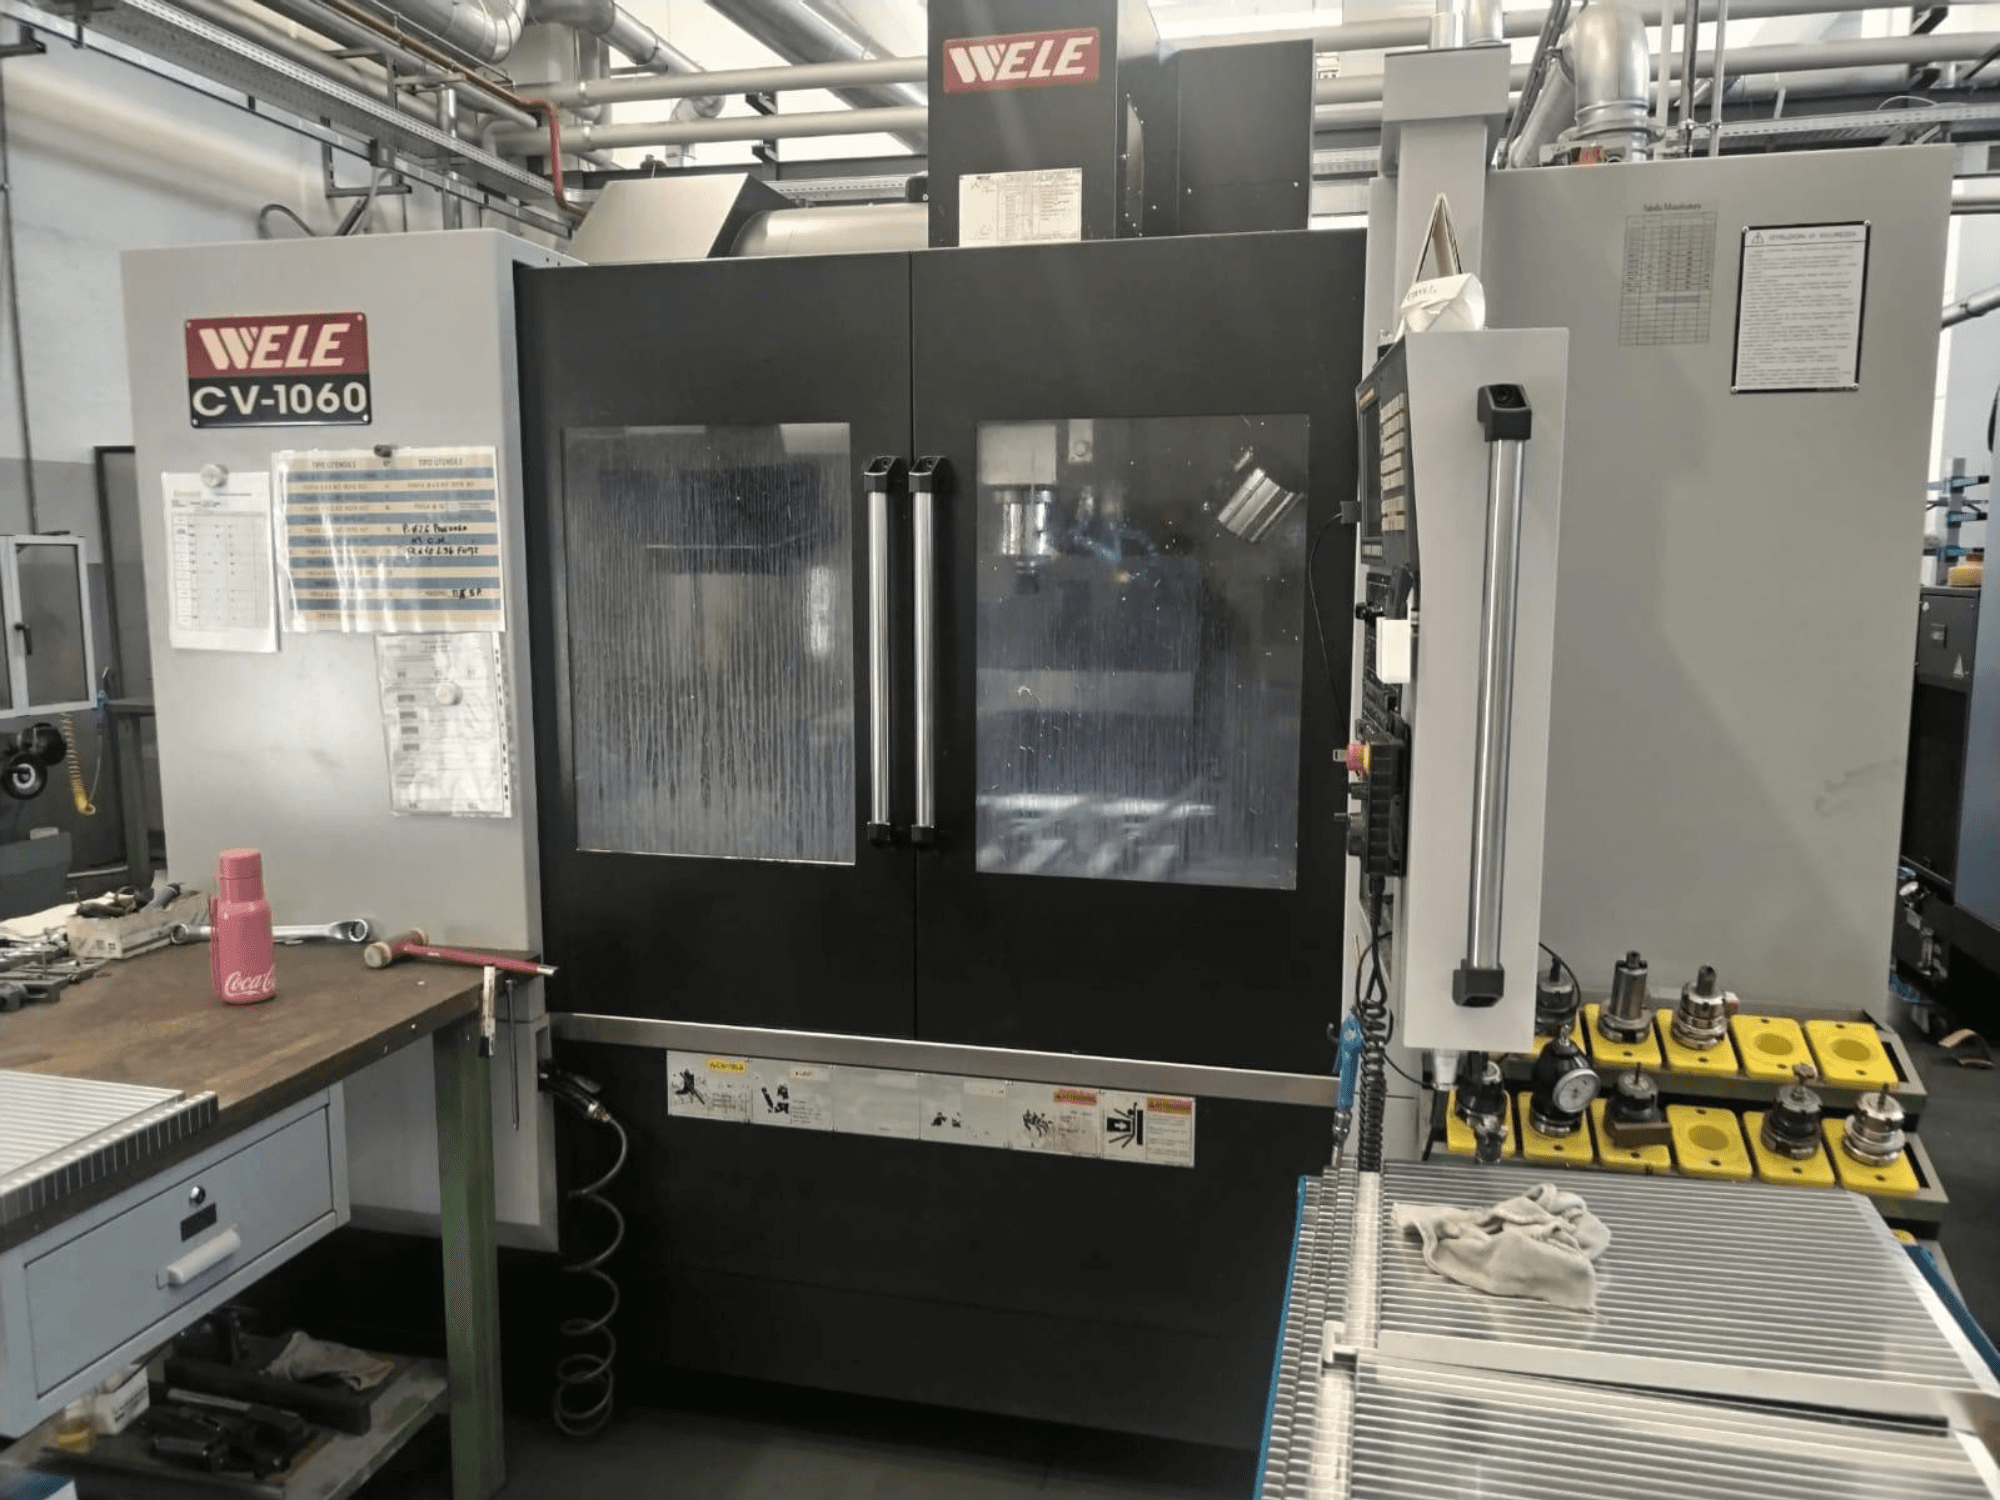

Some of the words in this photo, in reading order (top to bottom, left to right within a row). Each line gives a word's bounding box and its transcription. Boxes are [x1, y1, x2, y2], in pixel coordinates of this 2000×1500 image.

[949, 37, 1094, 83] WELE
[199, 322, 351, 370] WELE
[192, 382, 367, 416] CV-1060
